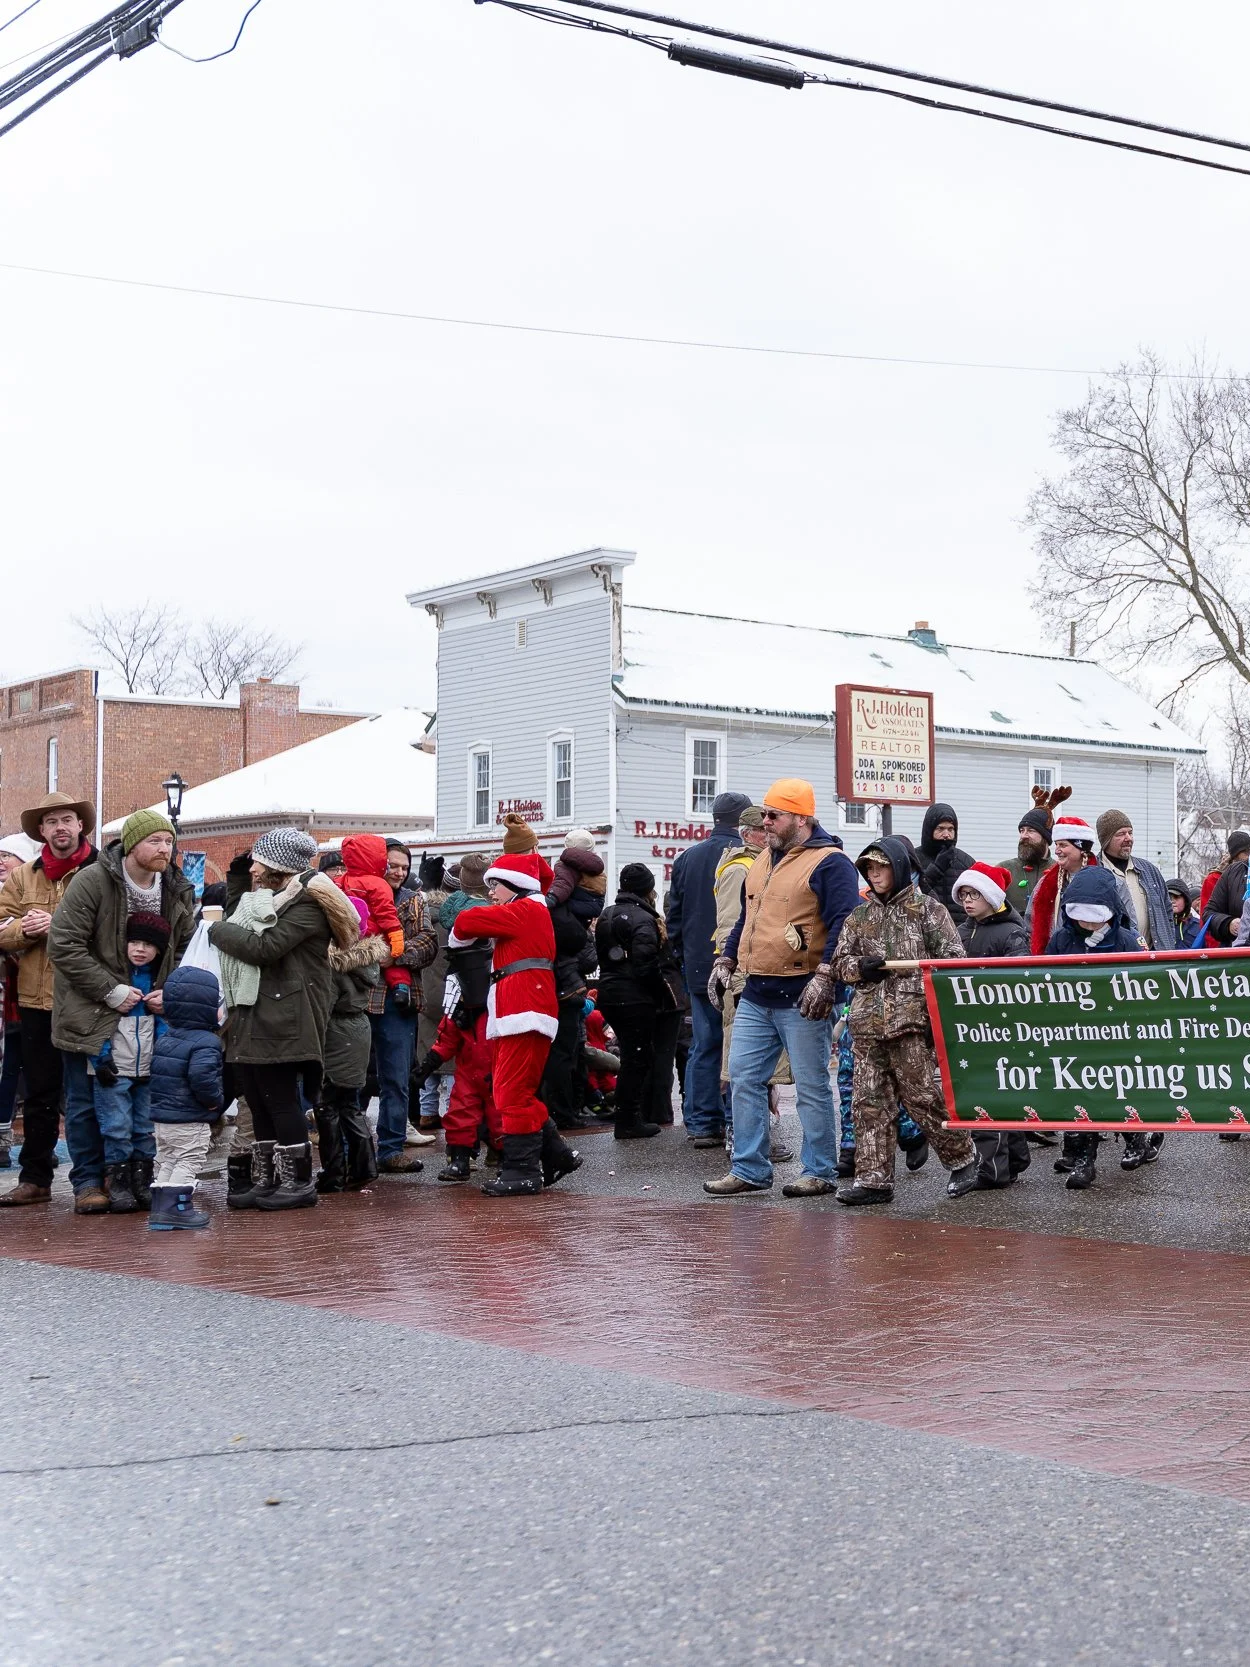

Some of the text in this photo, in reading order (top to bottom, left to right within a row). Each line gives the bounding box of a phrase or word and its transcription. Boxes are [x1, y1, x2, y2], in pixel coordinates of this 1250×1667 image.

[872, 716, 924, 728] & ASSOCIATES
[862, 740, 920, 753] REALTOR
[859, 759, 926, 772] DDA SPONSORED
[855, 771, 923, 783] CARRIAGE RIDES
[857, 783, 922, 794] 12 13 19 20
[652, 845, 662, 857] &
[948, 973, 1096, 1010] Honoring
[1110, 971, 1160, 1000] the
[955, 1022, 1011, 1042] Police
[1014, 1021, 1131, 1046] Department
[1137, 1019, 1173, 1040] and
[1178, 1018, 1219, 1038] Fire
[996, 1057, 1042, 1090] for
[1049, 1055, 1187, 1100] Keeping
[1196, 1064, 1232, 1090] us
